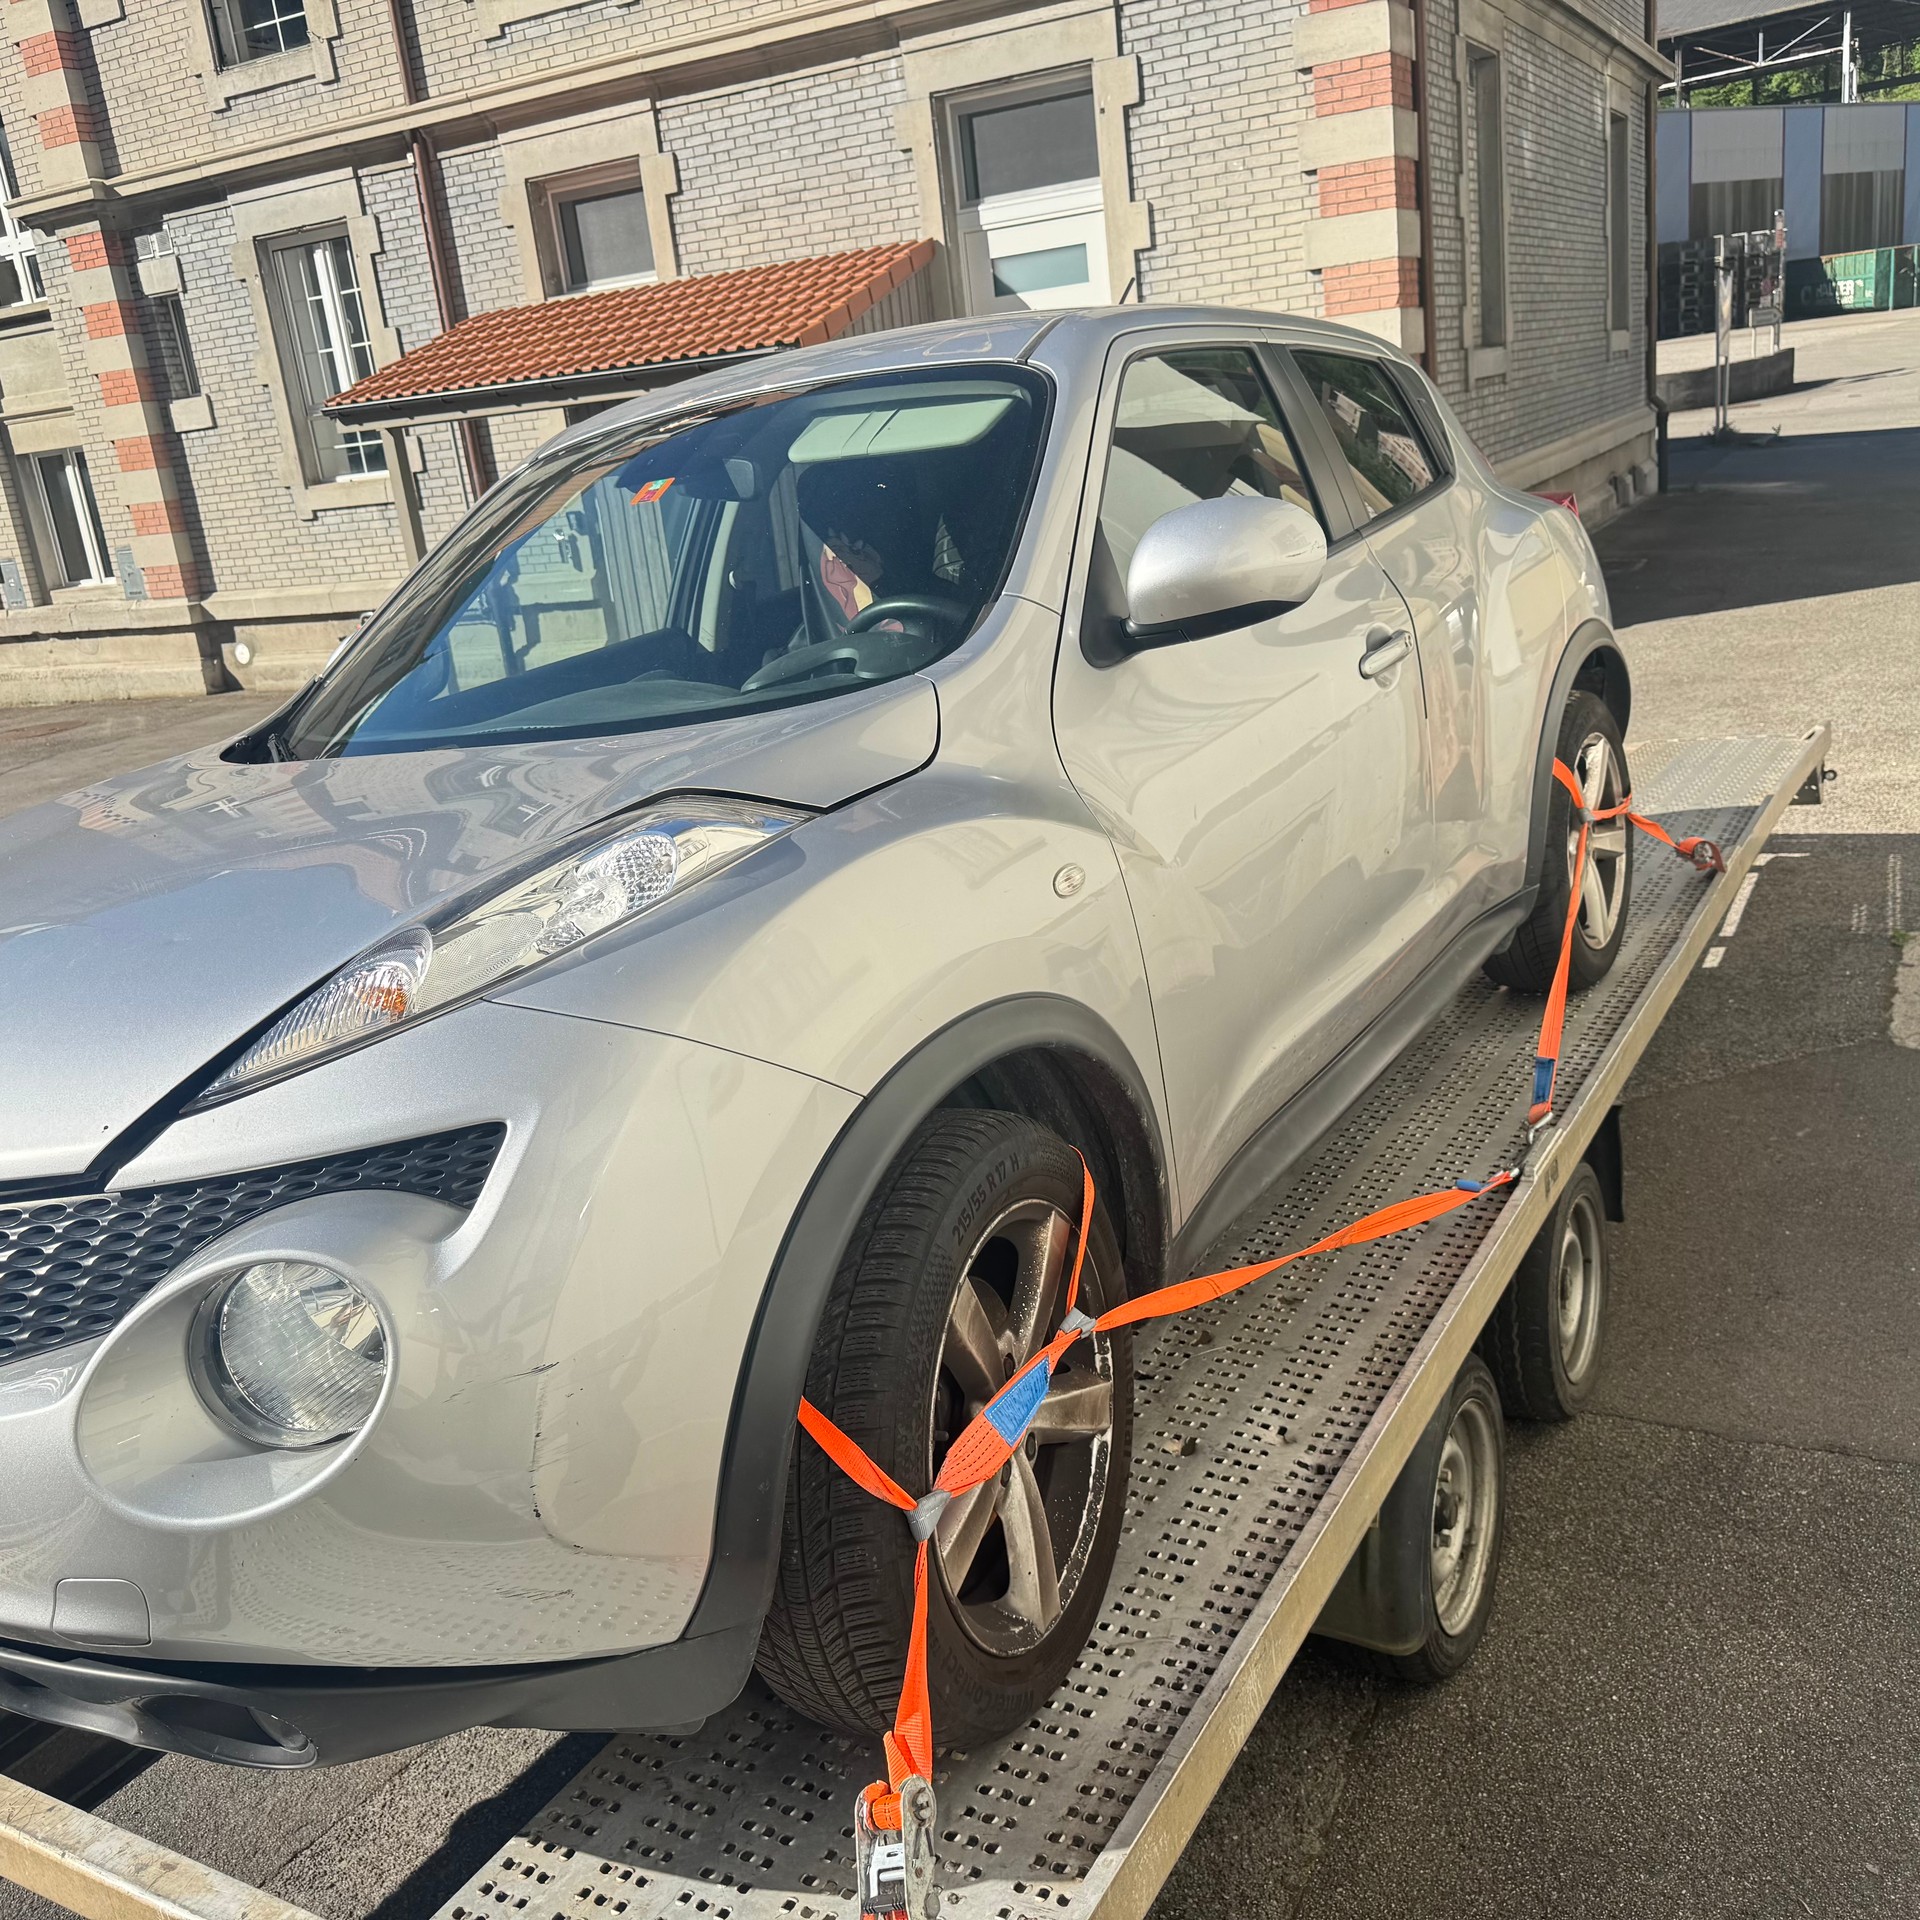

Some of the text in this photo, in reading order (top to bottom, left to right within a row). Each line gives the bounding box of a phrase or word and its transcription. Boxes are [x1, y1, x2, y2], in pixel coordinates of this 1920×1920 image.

[952, 1184, 987, 1247] 215/55
[1009, 1152, 1020, 1172] H
[940, 1646, 1034, 1714] WinterContact
